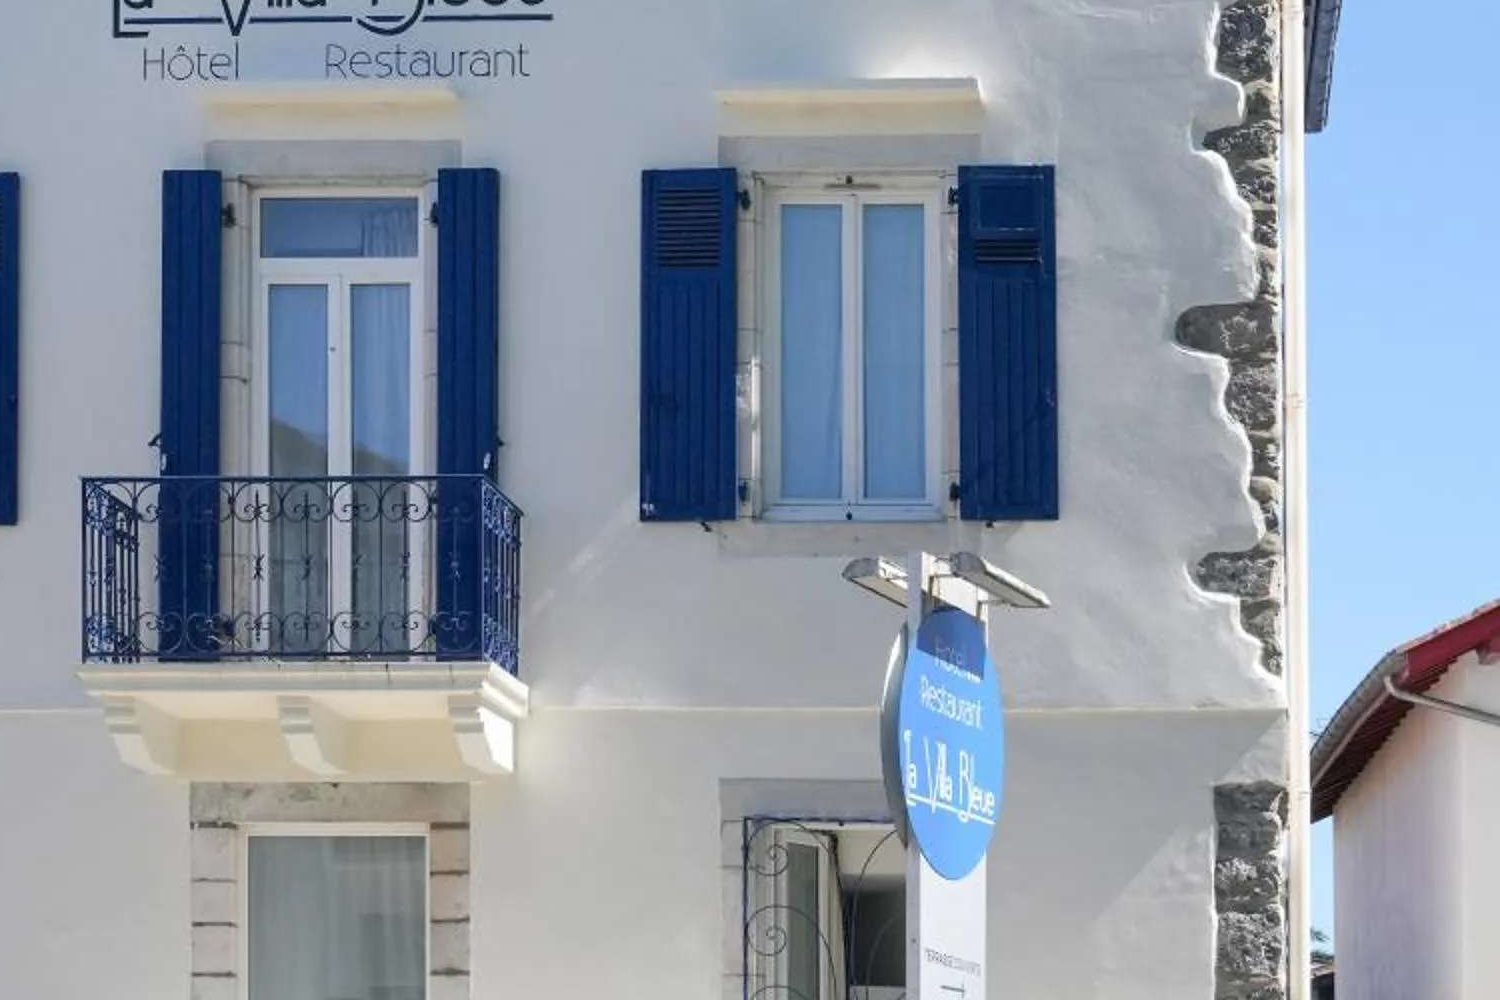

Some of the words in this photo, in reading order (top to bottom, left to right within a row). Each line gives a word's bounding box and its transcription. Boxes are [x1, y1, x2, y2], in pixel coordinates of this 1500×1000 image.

[142, 41, 240, 81] Hôtel
[324, 42, 531, 79] Restaurant
[919, 673, 984, 731] Restaurant
[903, 728, 918, 808] La
[922, 734, 953, 814] Villa
[957, 749, 996, 824] Bleue
